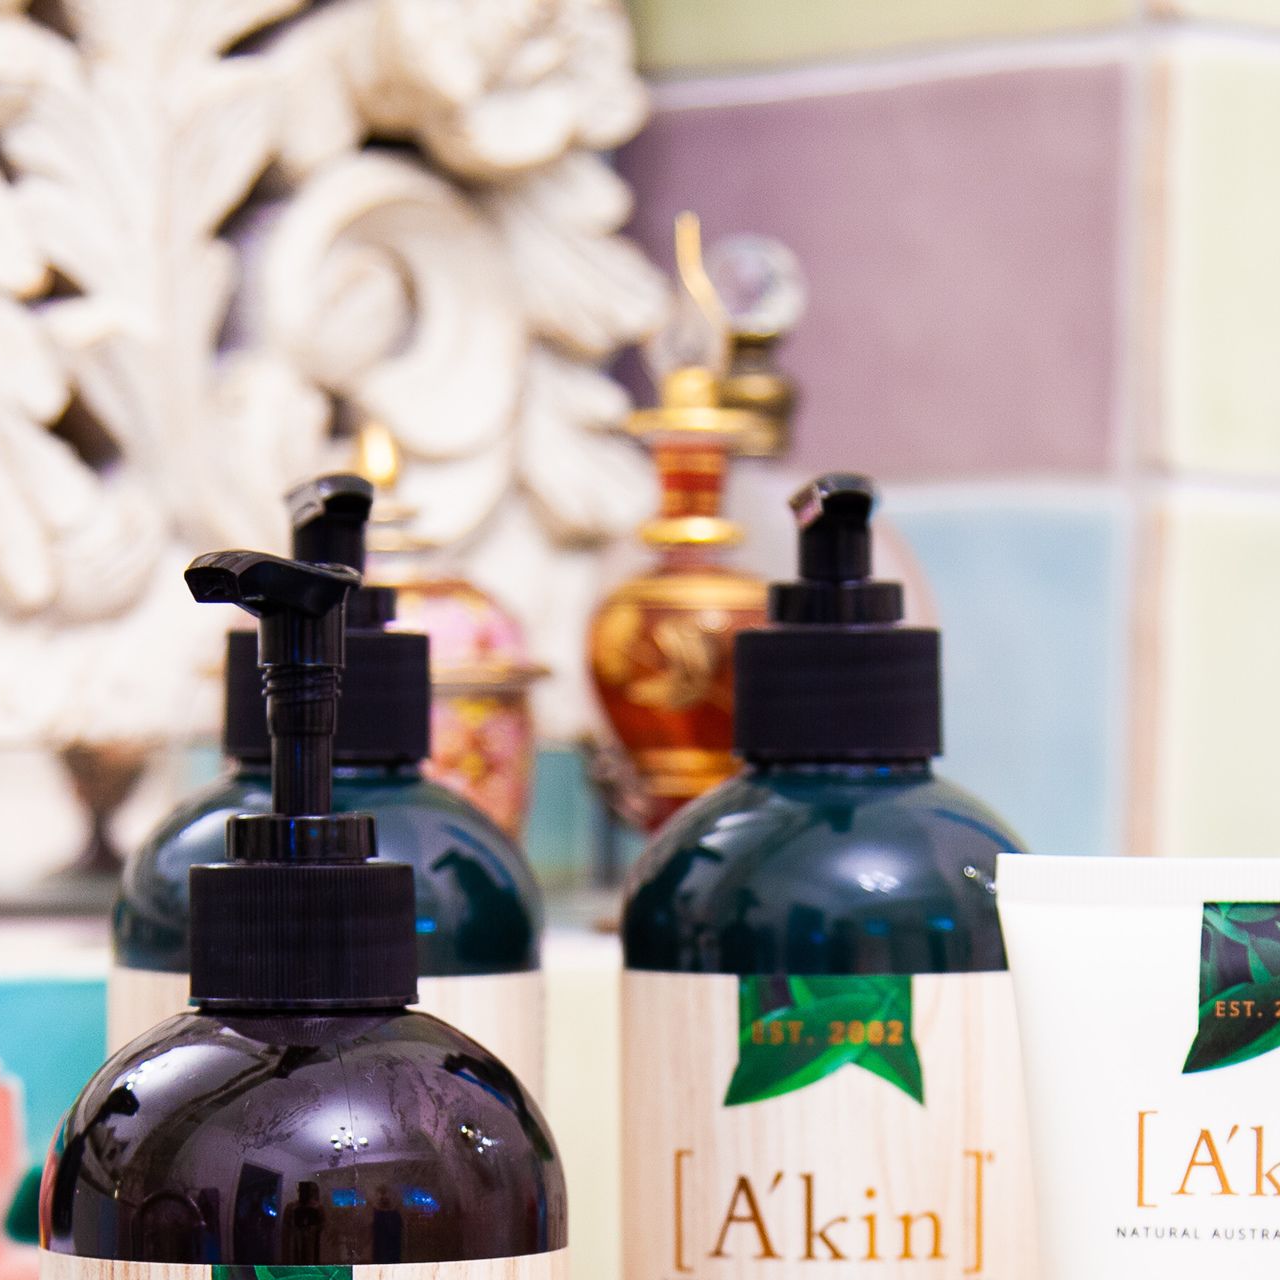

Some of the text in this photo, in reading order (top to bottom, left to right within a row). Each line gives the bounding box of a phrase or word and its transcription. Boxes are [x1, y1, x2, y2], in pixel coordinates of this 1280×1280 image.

[1214, 1000, 1263, 1018] EST.
[751, 1020, 904, 1045] EST. 2002
[1115, 1225, 1201, 1241] NATURAL
